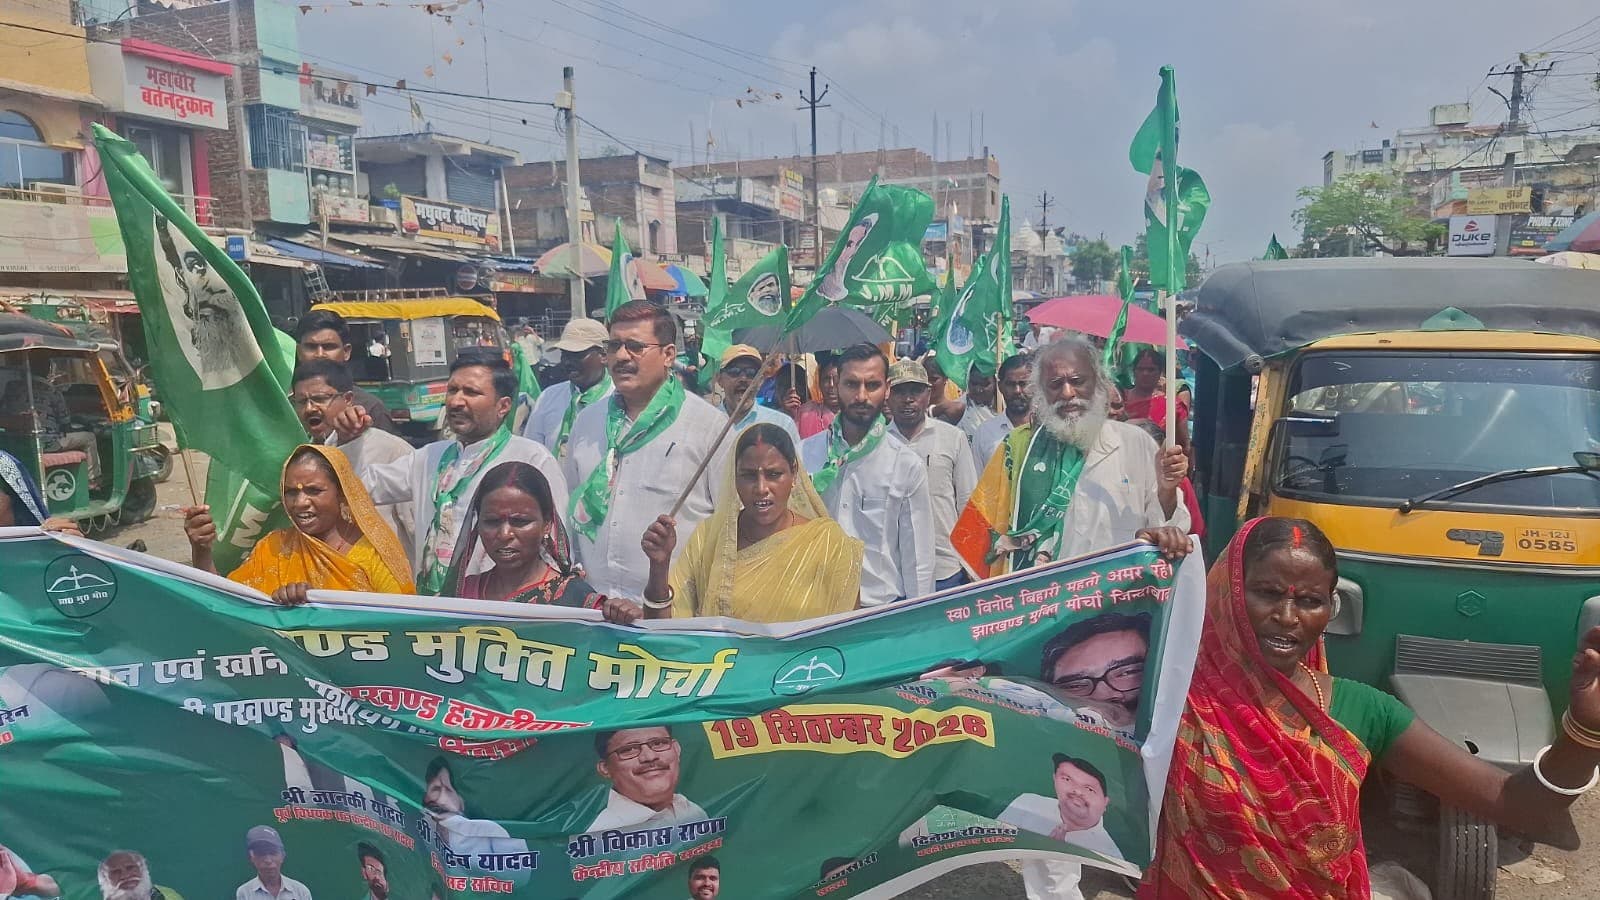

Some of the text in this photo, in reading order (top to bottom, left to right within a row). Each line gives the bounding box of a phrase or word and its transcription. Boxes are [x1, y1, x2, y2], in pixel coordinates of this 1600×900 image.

[1527, 216, 1553, 227] PHONE
[1452, 233, 1491, 242] DUKE
[1518, 538, 1576, 552] 0585
[976, 595, 1014, 614] विनोद
[1020, 582, 1060, 606] बिहारी
[1066, 571, 1101, 592] महतो
[1107, 566, 1144, 582] अमर
[971, 614, 1025, 641] झारखण्ड
[1065, 590, 1103, 611] मोर्चा
[152, 649, 206, 685] एवं
[279, 629, 391, 662] ण्ड
[405, 626, 576, 692] मुक्ति
[588, 643, 739, 699] मोर्चा
[711, 708, 988, 753] 19 सितम्बर 2026
[281, 786, 306, 804] श्री
[309, 789, 367, 811] जानकी
[566, 833, 597, 858] श्री
[600, 826, 674, 854] विकास
[478, 850, 540, 872] यादव
[470, 876, 515, 894] सचिव
